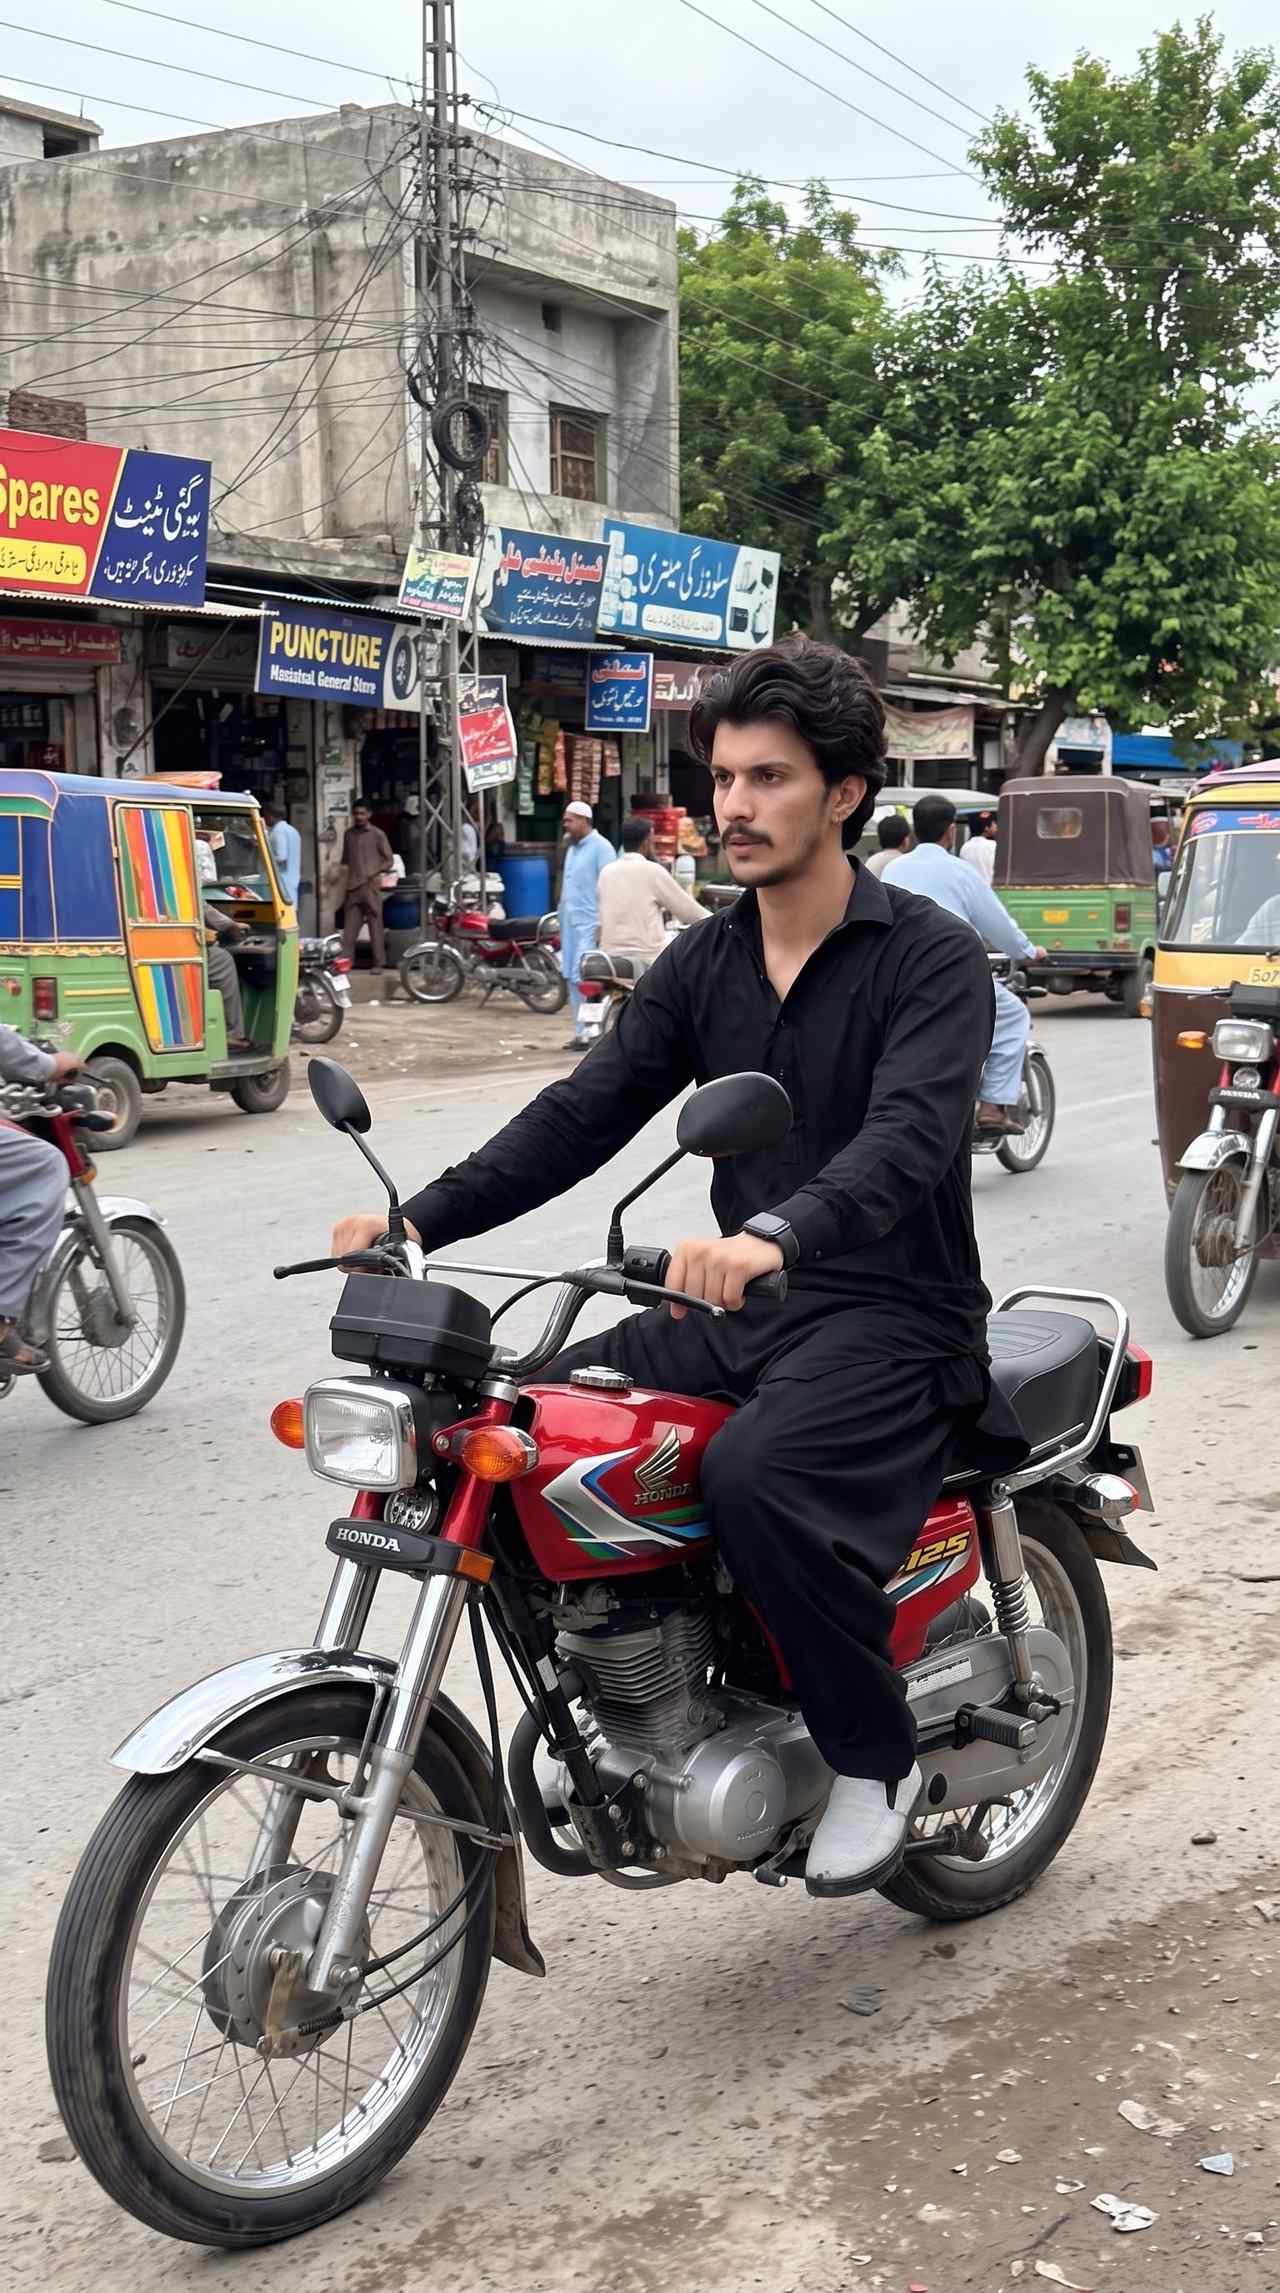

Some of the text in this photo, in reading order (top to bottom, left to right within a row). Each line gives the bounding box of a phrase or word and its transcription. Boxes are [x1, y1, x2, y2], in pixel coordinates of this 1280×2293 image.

[270, 621, 383, 669] PUNCTURE
[317, 671, 352, 690] General
[336, 1528, 400, 1552] HONDA
[904, 1530, 971, 1572] 125
